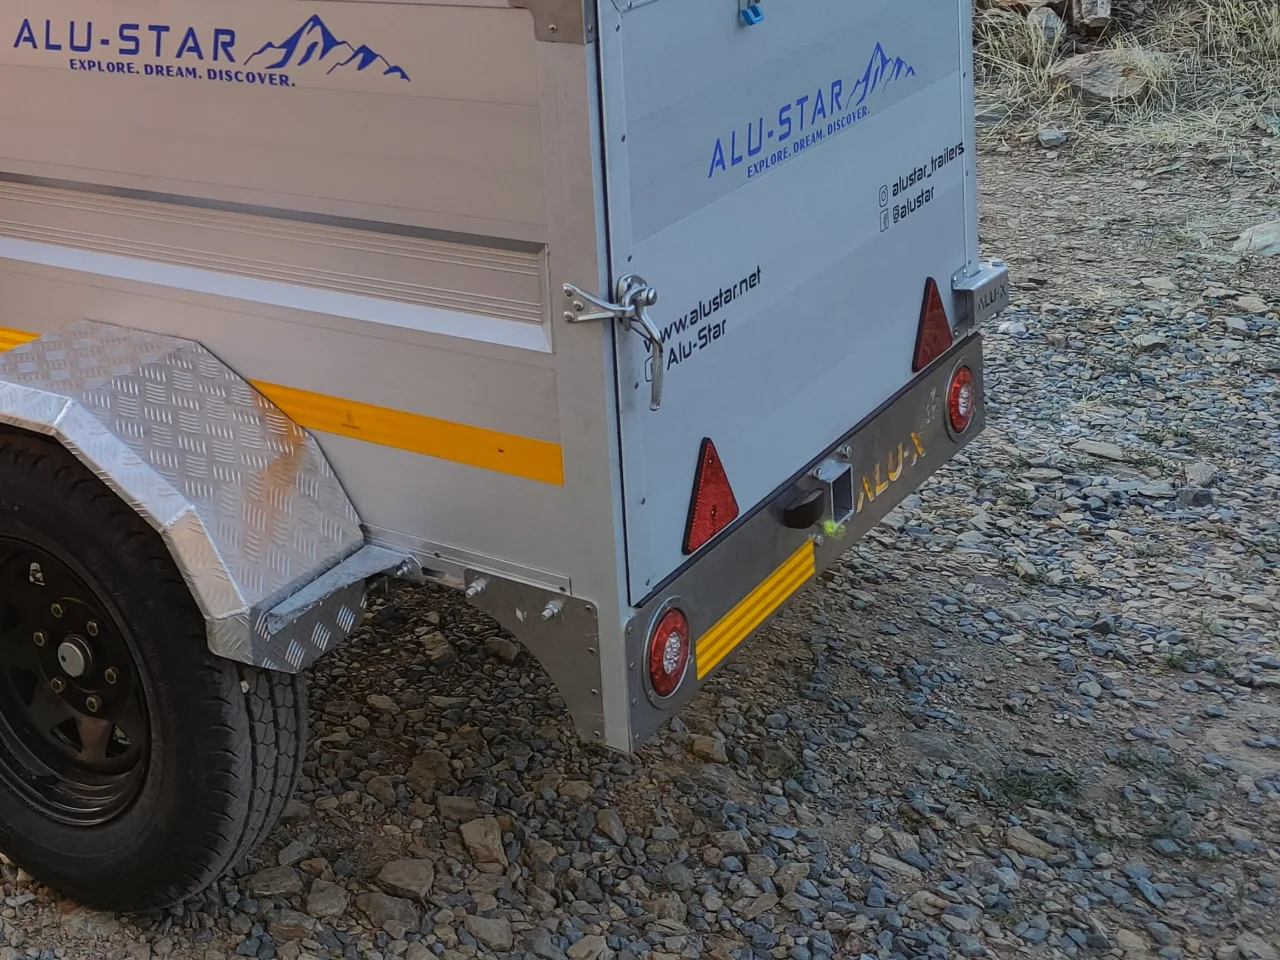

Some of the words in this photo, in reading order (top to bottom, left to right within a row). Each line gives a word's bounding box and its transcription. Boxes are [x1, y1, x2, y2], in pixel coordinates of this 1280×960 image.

[13, 18, 236, 63] ALU-STAR
[70, 58, 140, 75] EXPLORE.
[144, 63, 203, 80] DREAM.
[207, 68, 297, 88] DISCOVER.
[707, 78, 843, 179] ALU-STAR
[747, 146, 792, 179] EXPLORE.
[793, 129, 826, 154] DREAM.
[827, 105, 871, 136] DISCOVER.
[892, 141, 965, 197] alustar_trailers
[892, 186, 935, 224] @alustar
[978, 284, 1007, 310] ALU-X
[666, 319, 727, 371] Alu-Star
[856, 431, 927, 514] ALU-X
